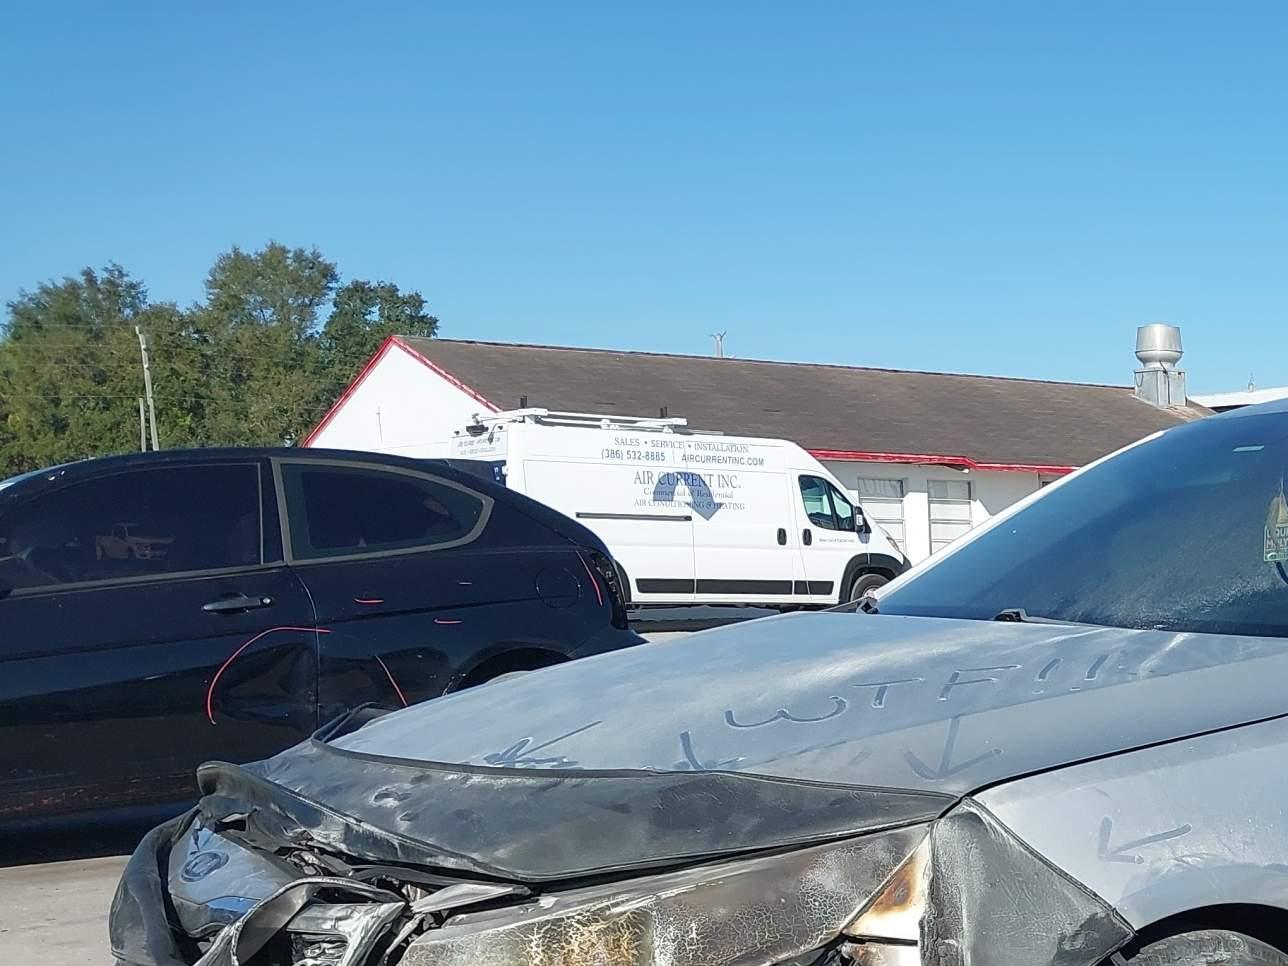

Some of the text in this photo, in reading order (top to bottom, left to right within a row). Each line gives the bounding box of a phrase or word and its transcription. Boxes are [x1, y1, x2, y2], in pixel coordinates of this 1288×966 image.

[614, 437, 749, 453] SALES SERVICE INSTALLATION
[601, 448, 765, 465] (386) 532-8885 AIRCURRENTINC.COM
[634, 470, 742, 489] AIR CURRENT INC.
[643, 487, 686, 497] Commercial
[696, 489, 734, 499] Residential
[633, 498, 647, 507] AIR
[647, 499, 704, 509] CONDITIONING
[713, 502, 745, 511] HEATING
